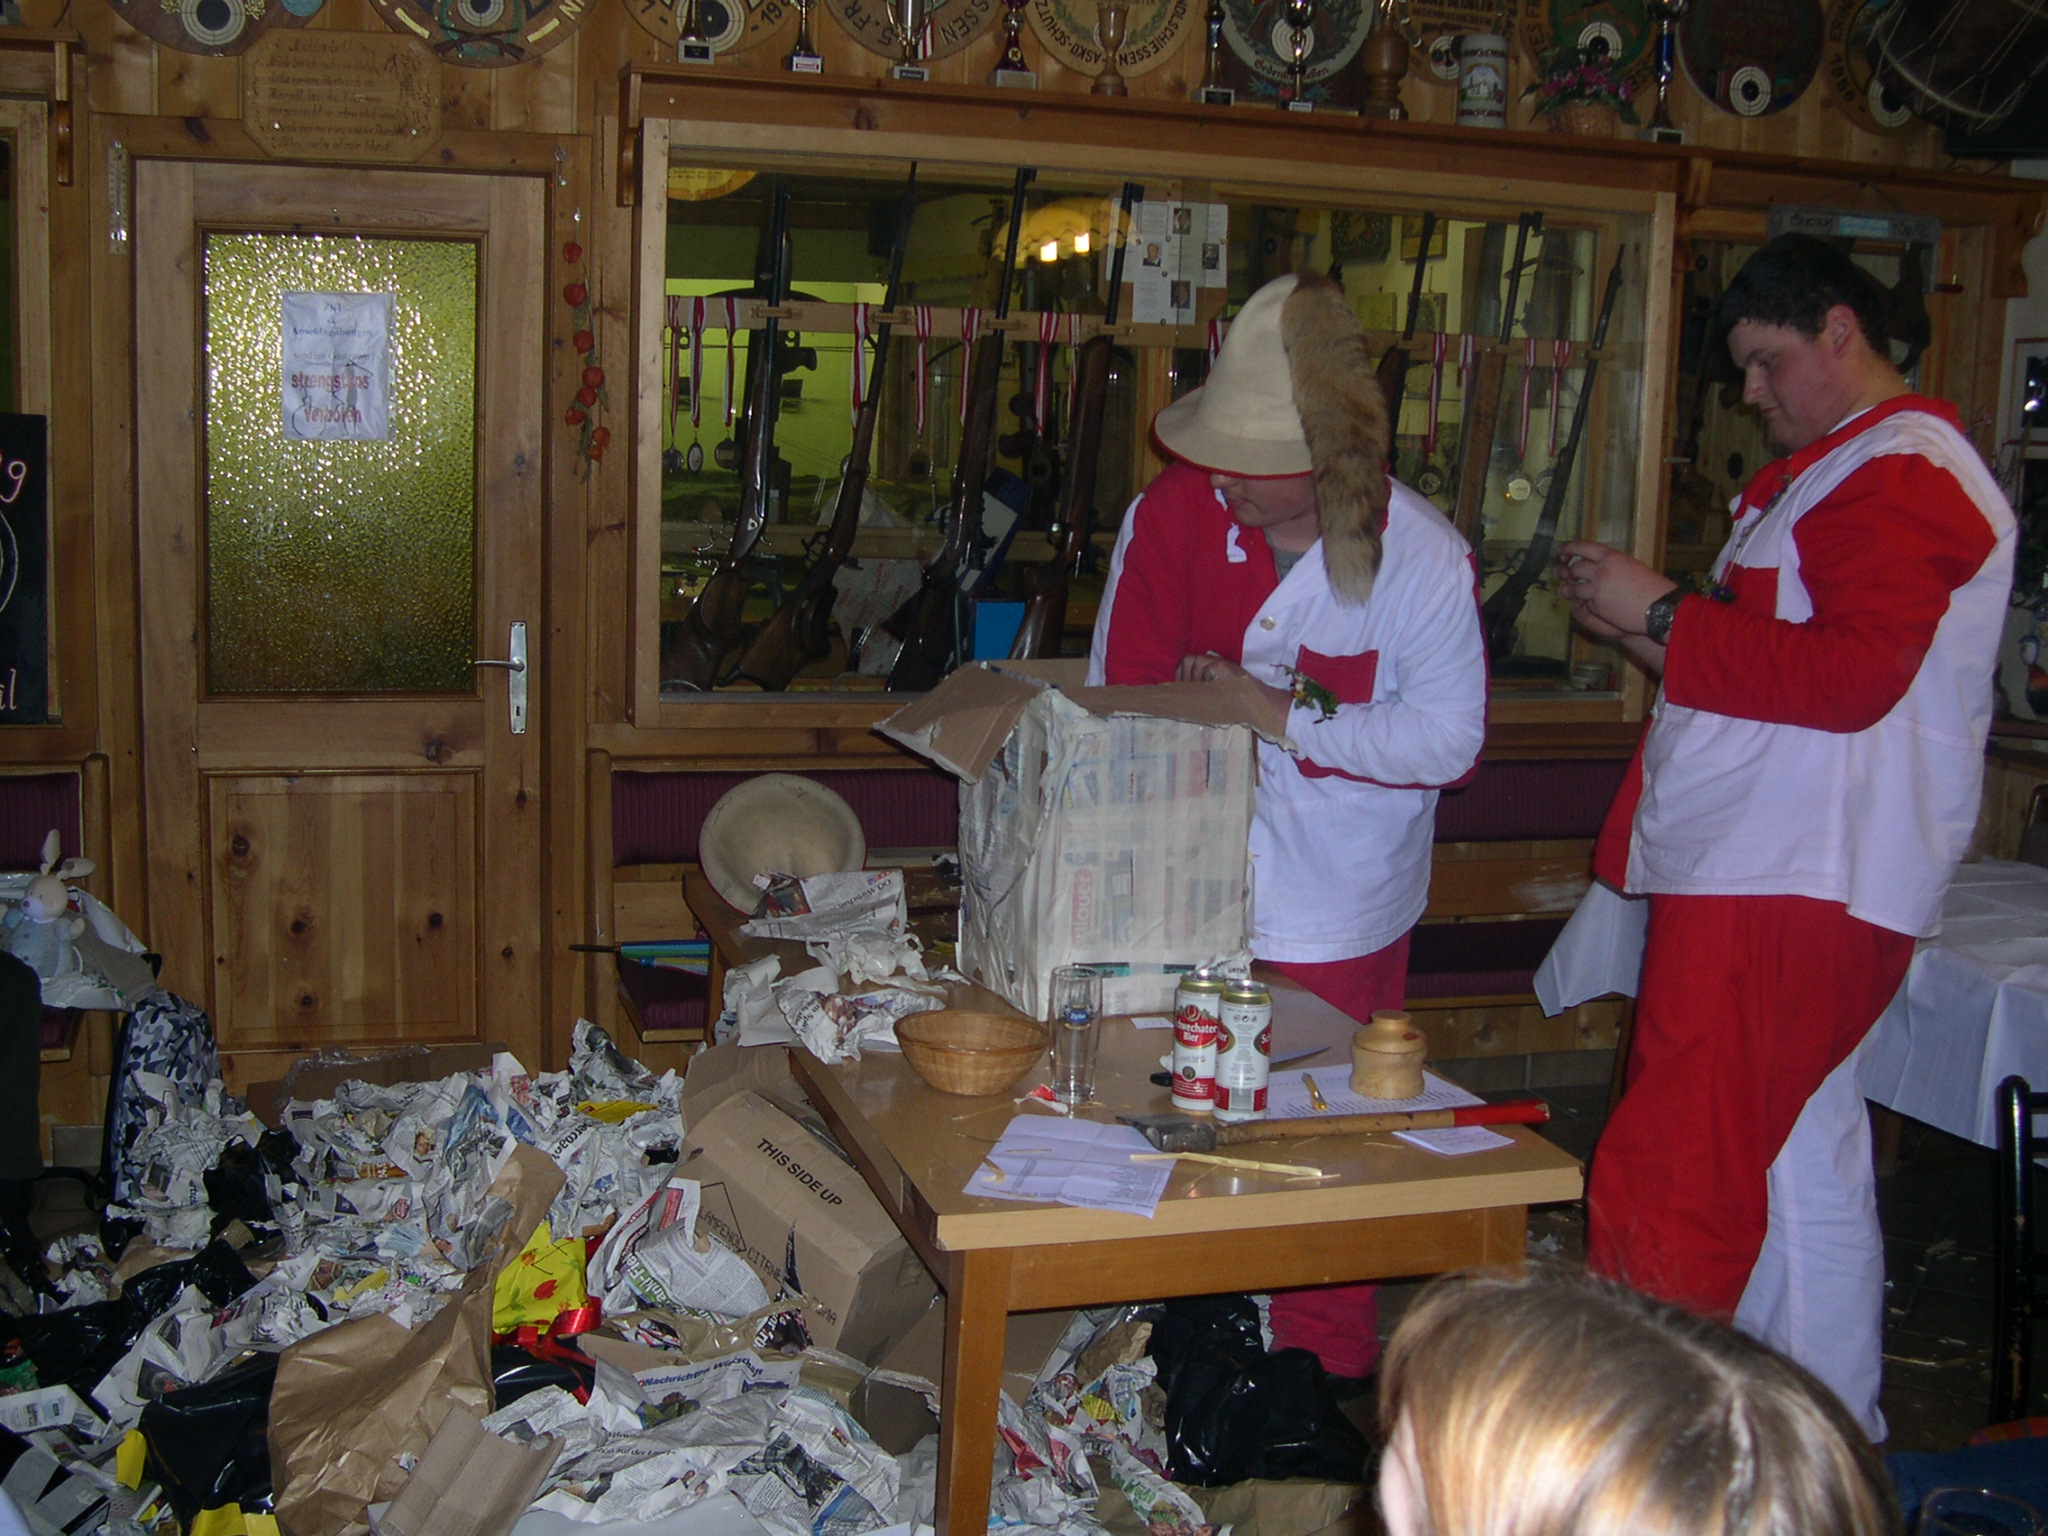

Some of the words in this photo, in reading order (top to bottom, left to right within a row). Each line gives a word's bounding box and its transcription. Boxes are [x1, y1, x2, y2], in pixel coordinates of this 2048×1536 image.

[1182, 1032, 1200, 1043] Bier
[757, 1138, 790, 1167] THIS
[787, 1164, 823, 1193] SIDE
[819, 1188, 843, 1207] UP
